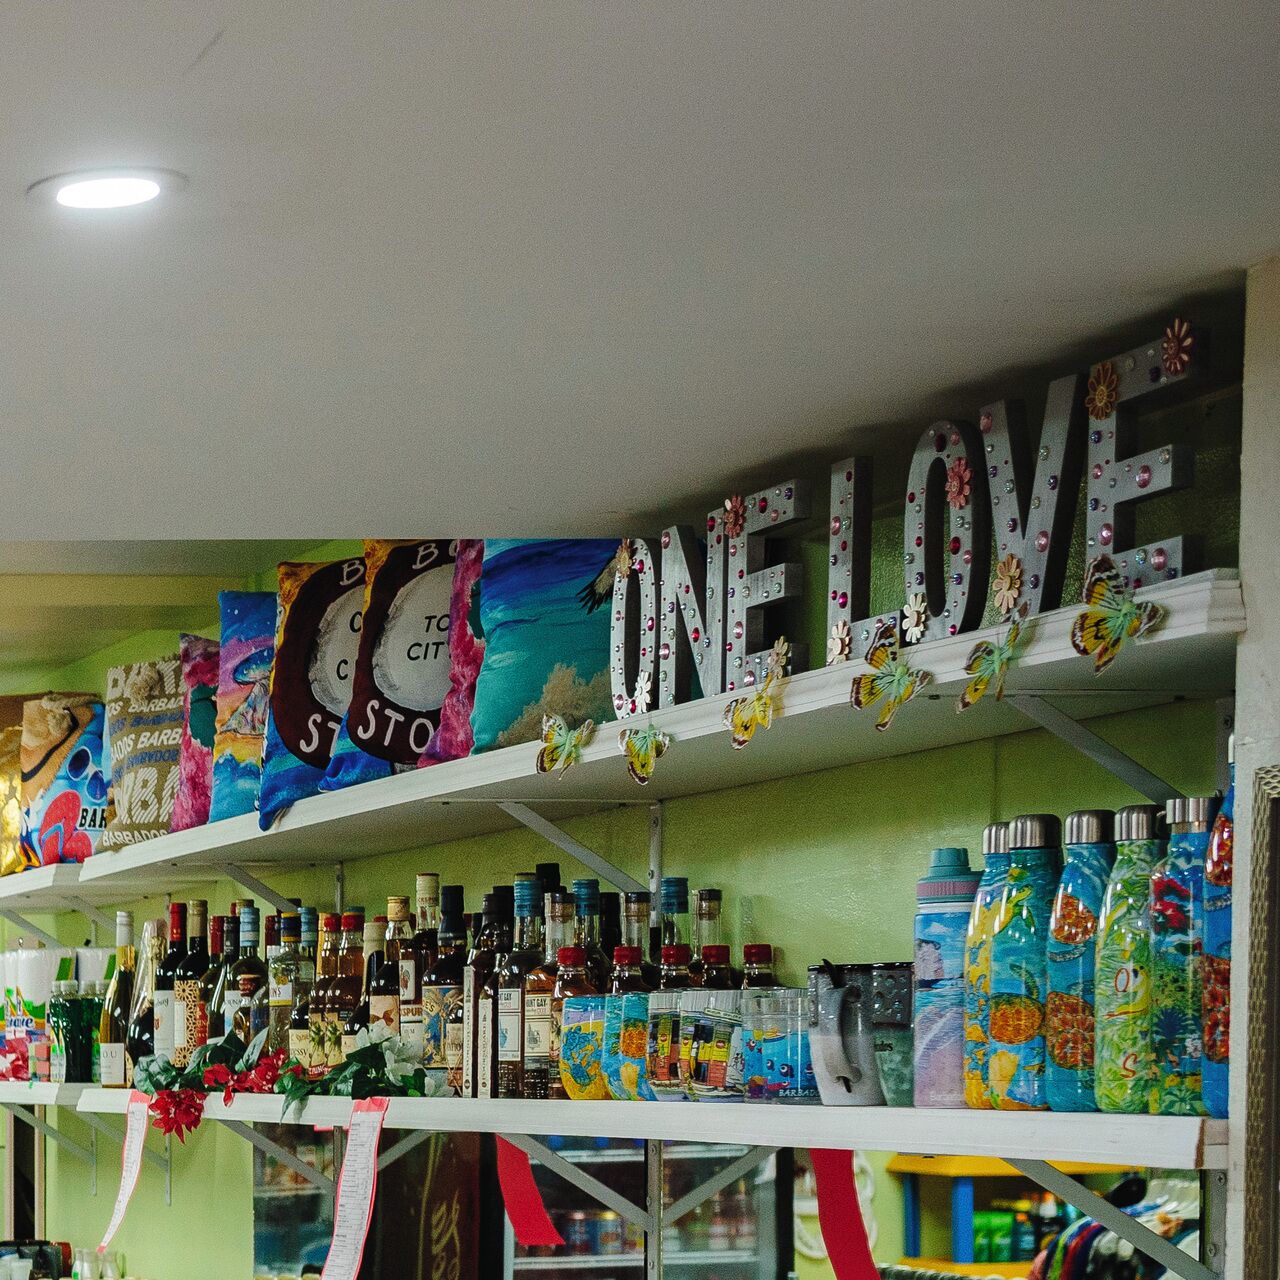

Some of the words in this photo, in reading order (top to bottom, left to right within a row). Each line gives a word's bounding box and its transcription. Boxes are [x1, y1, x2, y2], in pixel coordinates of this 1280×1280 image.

[609, 479, 808, 720] ONE
[828, 322, 1208, 666] LOVE
[406, 642, 452, 661] CIT
